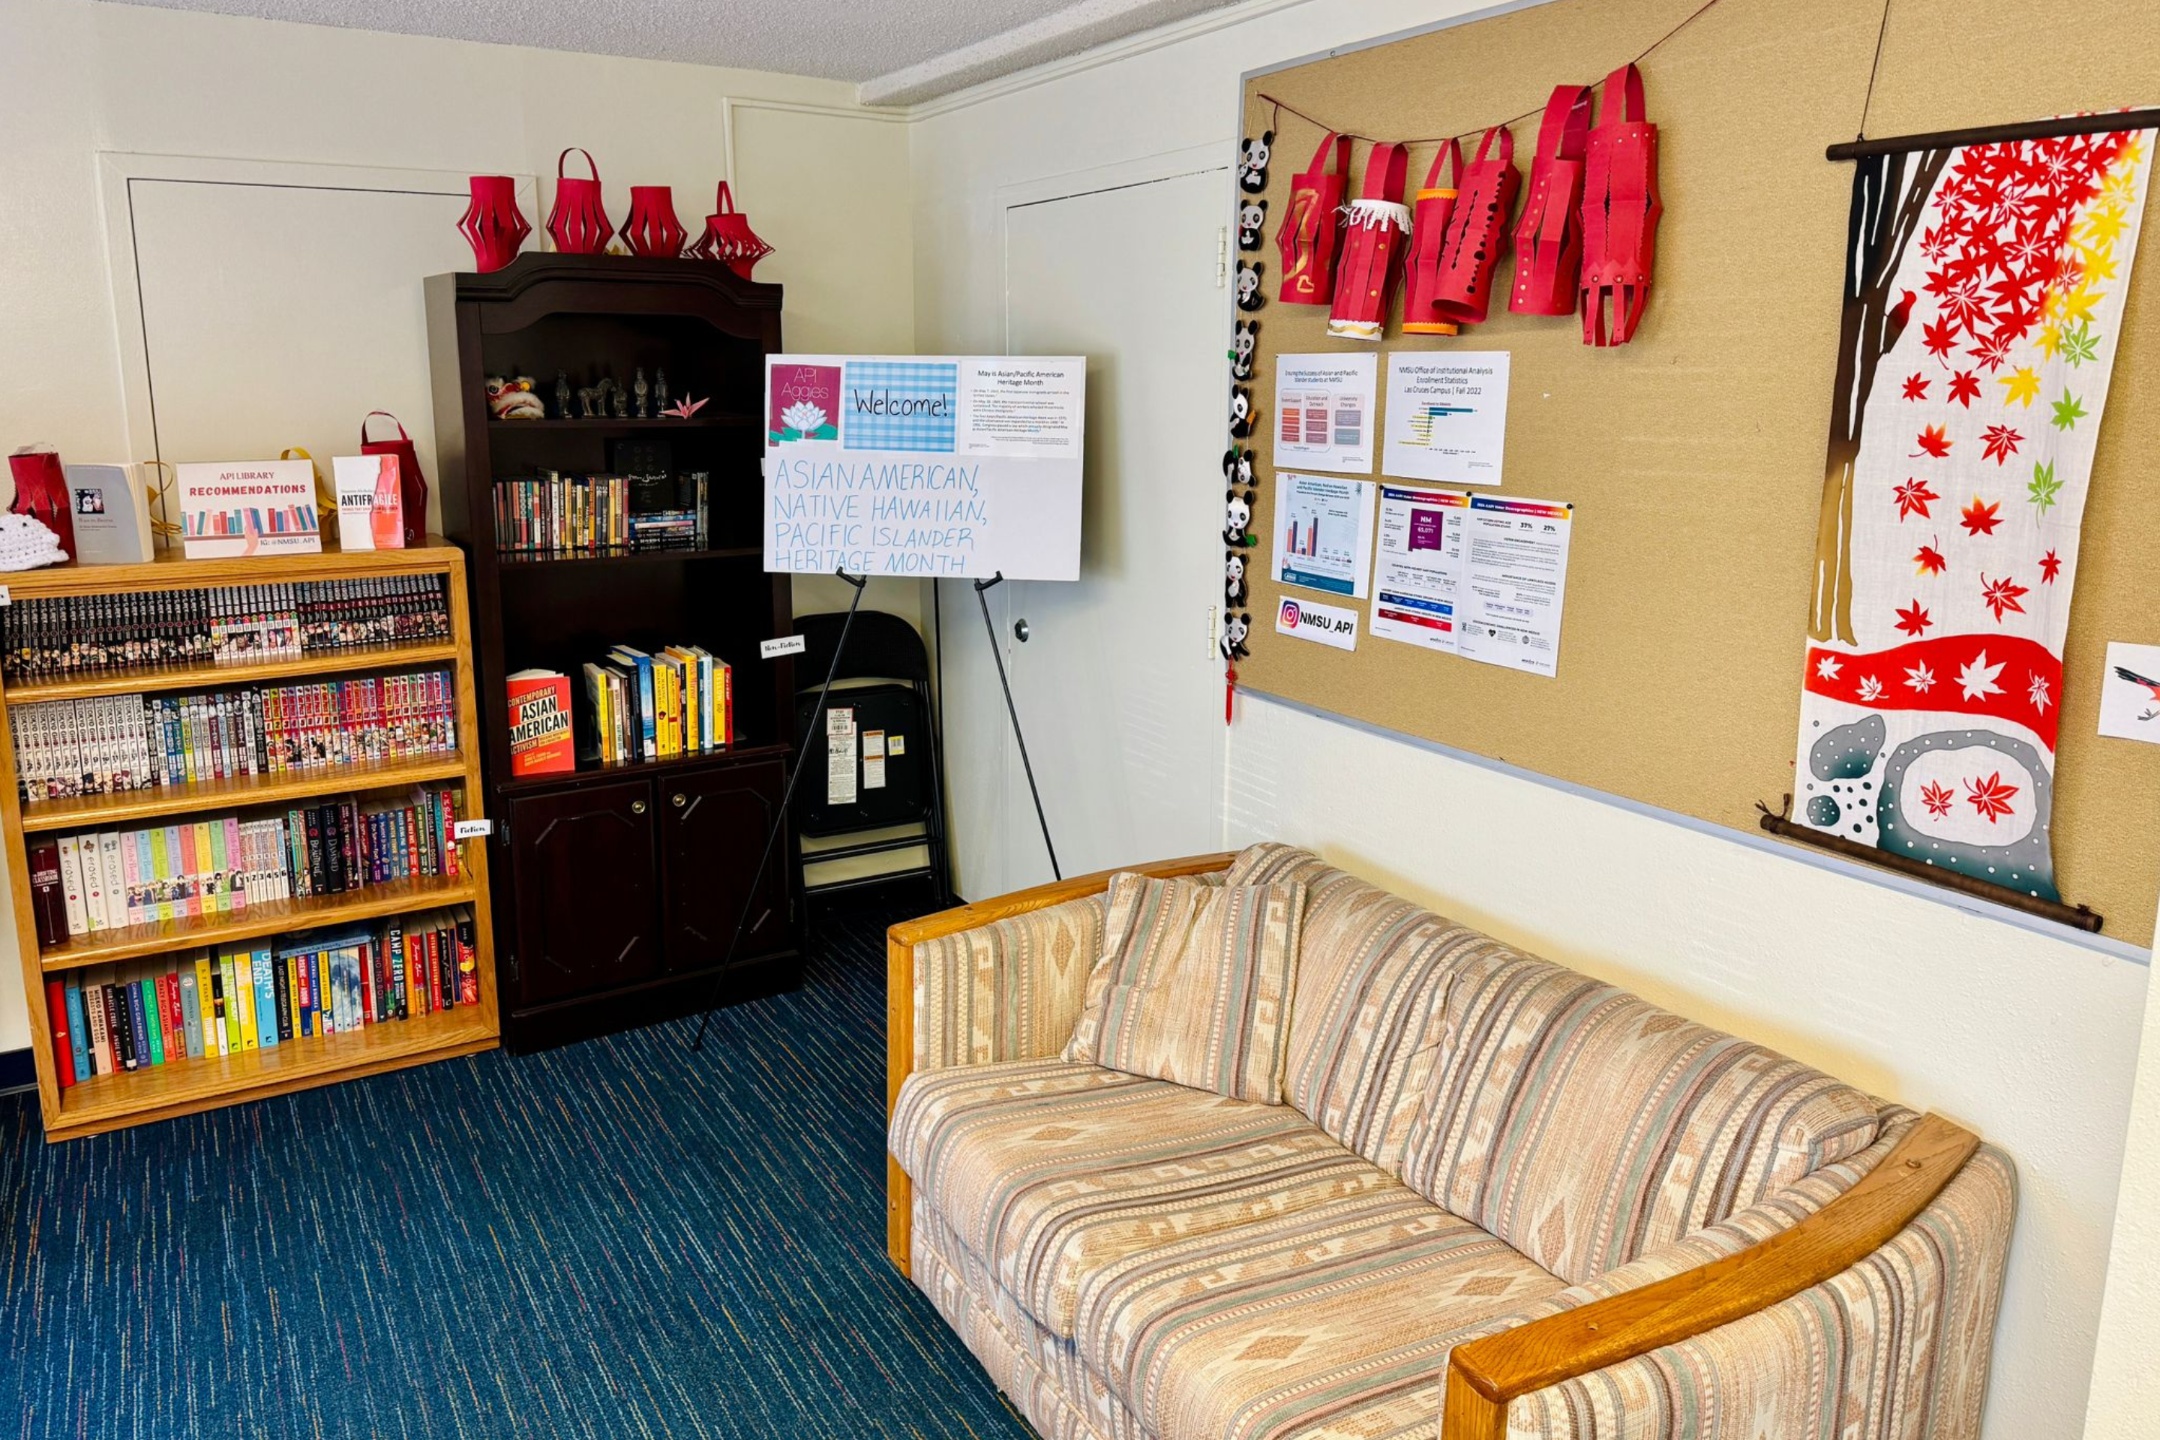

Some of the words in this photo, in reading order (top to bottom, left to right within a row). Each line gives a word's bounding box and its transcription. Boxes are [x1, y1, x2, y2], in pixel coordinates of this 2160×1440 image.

[794, 368, 816, 383] API
[1417, 376, 1443, 384] Enrollment
[1469, 367, 1493, 375] Analysis
[781, 382, 829, 401] Aggies
[854, 389, 947, 417] Welcome!
[1467, 387, 1481, 395] 2022
[220, 472, 235, 480] API
[236, 472, 274, 480] LIBRARY
[774, 459, 854, 491] ASIAN
[859, 464, 979, 497] AMERICAN,
[190, 485, 306, 496] RECOMMENDATIONS
[341, 494, 398, 506] ANTIFRAGILE
[774, 494, 859, 519] NATIVE
[872, 496, 987, 526] HAWAIIAN,
[776, 522, 862, 548] PACIFIC
[873, 527, 974, 550] ISLANDER
[775, 550, 875, 571] HERITAGE
[885, 552, 964, 574] MONTH
[1300, 611, 1353, 635] NMSU_API
[765, 642, 800, 651] Non-Fiction
[508, 686, 556, 707] CONTEMPORARY
[522, 696, 556, 722] ASIAN
[510, 711, 568, 744] AMERICAN
[310, 840, 322, 877] BEAUTIFUL
[328, 838, 338, 872] DAMNED
[64, 860, 76, 892] erased
[87, 857, 99, 889] erased
[108, 854, 120, 886] erased
[390, 929, 402, 954] CAMP
[253, 961, 263, 985] END
[298, 956, 306, 978] ARSENIC
[375, 957, 381, 968] NO
[392, 959, 404, 981] ZERO
[261, 952, 274, 999] DEATH'S
[107, 988, 115, 1011] MIRACLE
[97, 1010, 106, 1042] KAWAKAMI
[109, 1013, 117, 1028] CREEK
[135, 1012, 143, 1041] GIRLFRIEND
